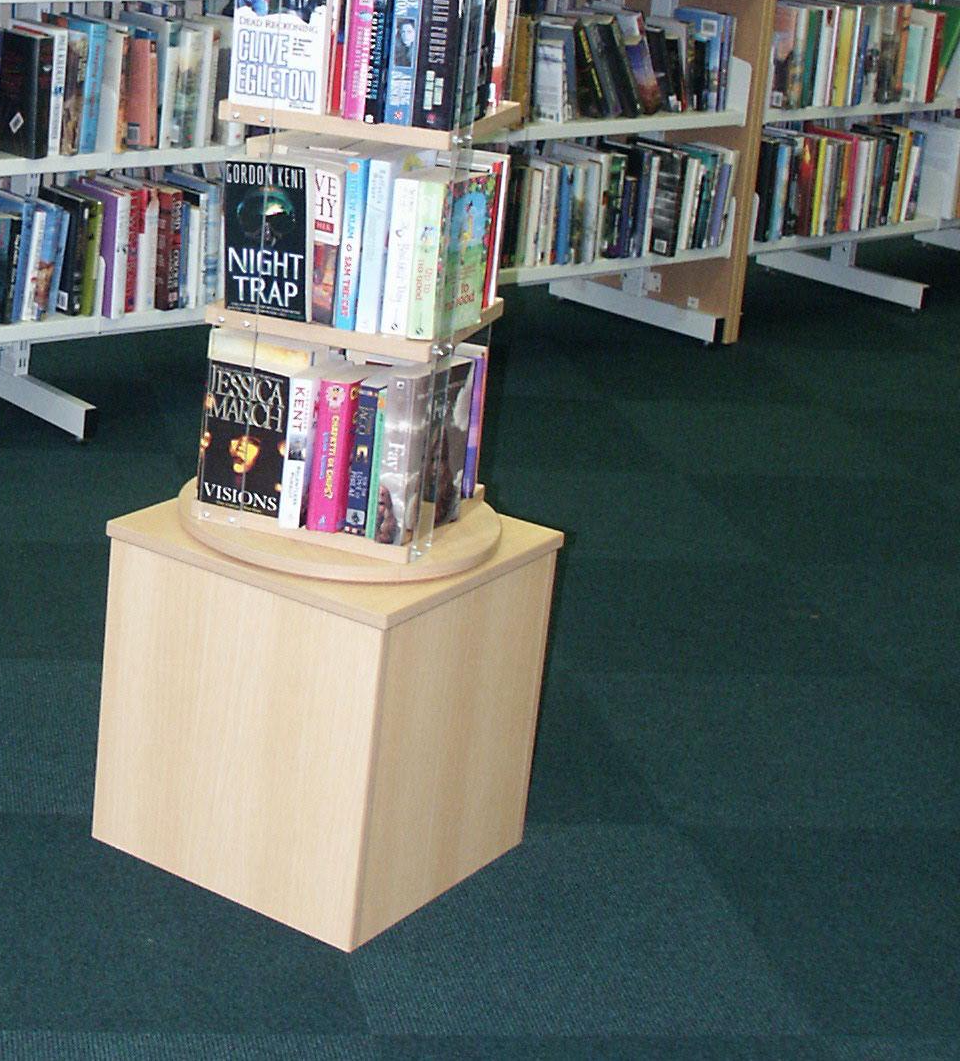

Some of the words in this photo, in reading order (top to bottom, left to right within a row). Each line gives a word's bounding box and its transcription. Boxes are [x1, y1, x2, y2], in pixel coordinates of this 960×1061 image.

[240, 16, 263, 28] DEAD
[238, 29, 290, 67] CLIVE
[428, 26, 447, 64] FORBES
[235, 62, 316, 103] EGLETON
[226, 163, 272, 187] GORDON
[277, 166, 306, 190] KENT
[347, 214, 357, 239] KLAM
[228, 247, 304, 280] NIGHT
[343, 256, 352, 276] SAM
[416, 260, 425, 274] no
[424, 268, 433, 284] Up
[232, 275, 299, 308] TRAP
[342, 280, 351, 298] THE
[424, 286, 431, 294] to
[341, 300, 350, 317] CAT
[210, 365, 285, 409] JESSICA
[207, 393, 283, 434] MARCH
[292, 386, 305, 432] KENT
[327, 415, 340, 456] CHAPATTI
[386, 442, 404, 470] Fay
[203, 482, 278, 512] VISIONS
